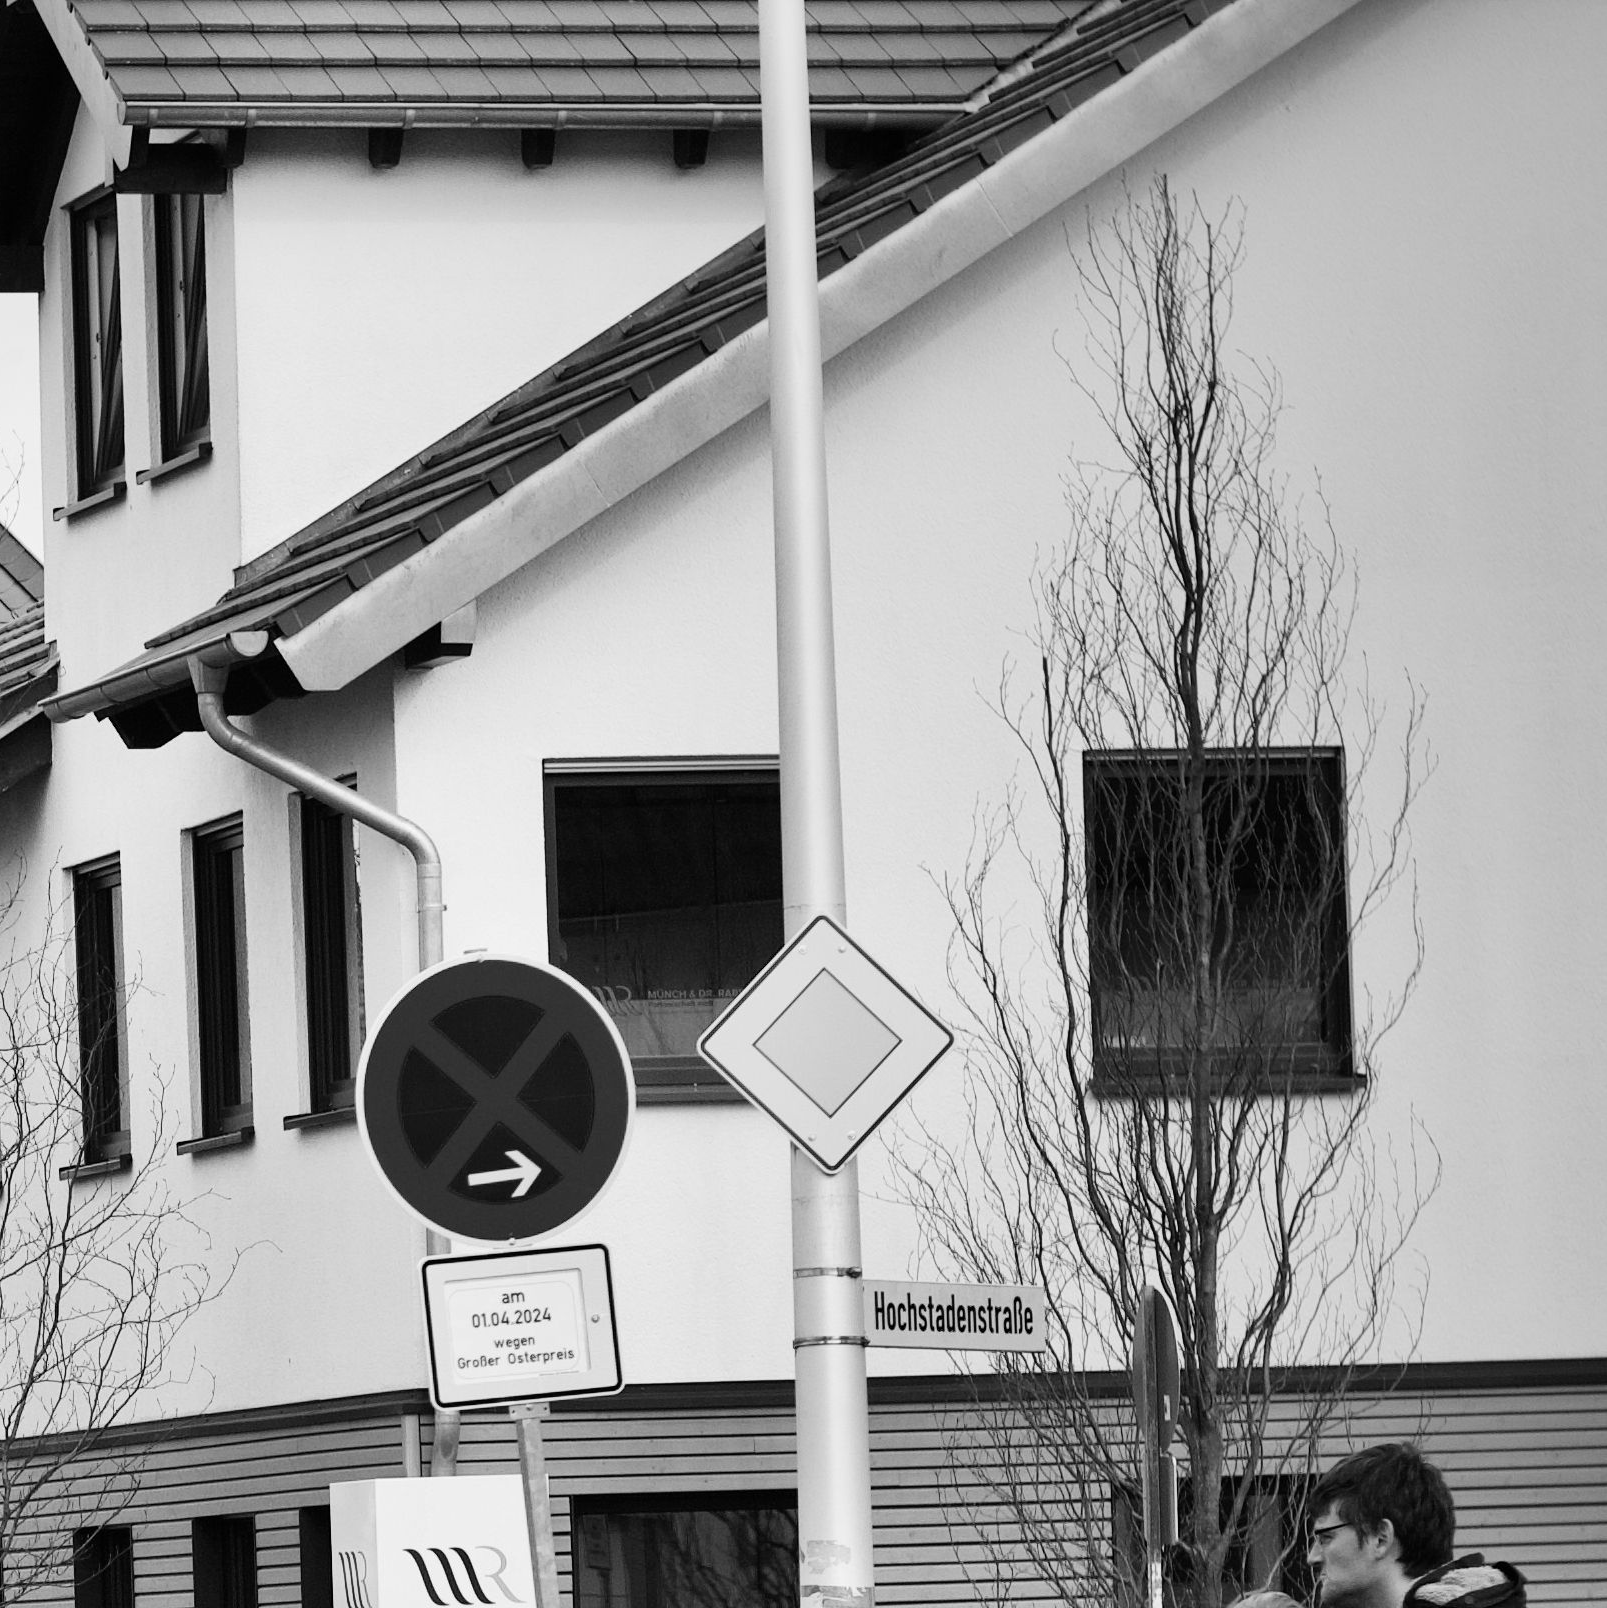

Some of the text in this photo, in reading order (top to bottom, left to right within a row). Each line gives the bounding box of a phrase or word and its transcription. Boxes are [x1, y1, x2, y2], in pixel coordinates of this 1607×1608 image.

[502, 1291, 525, 1304] am
[471, 1307, 552, 1328] 01.04.2024
[874, 1290, 1034, 1335] Hochstadenstraße
[494, 1336, 536, 1350] wegen
[457, 1347, 575, 1369] Großer Osterpreis
